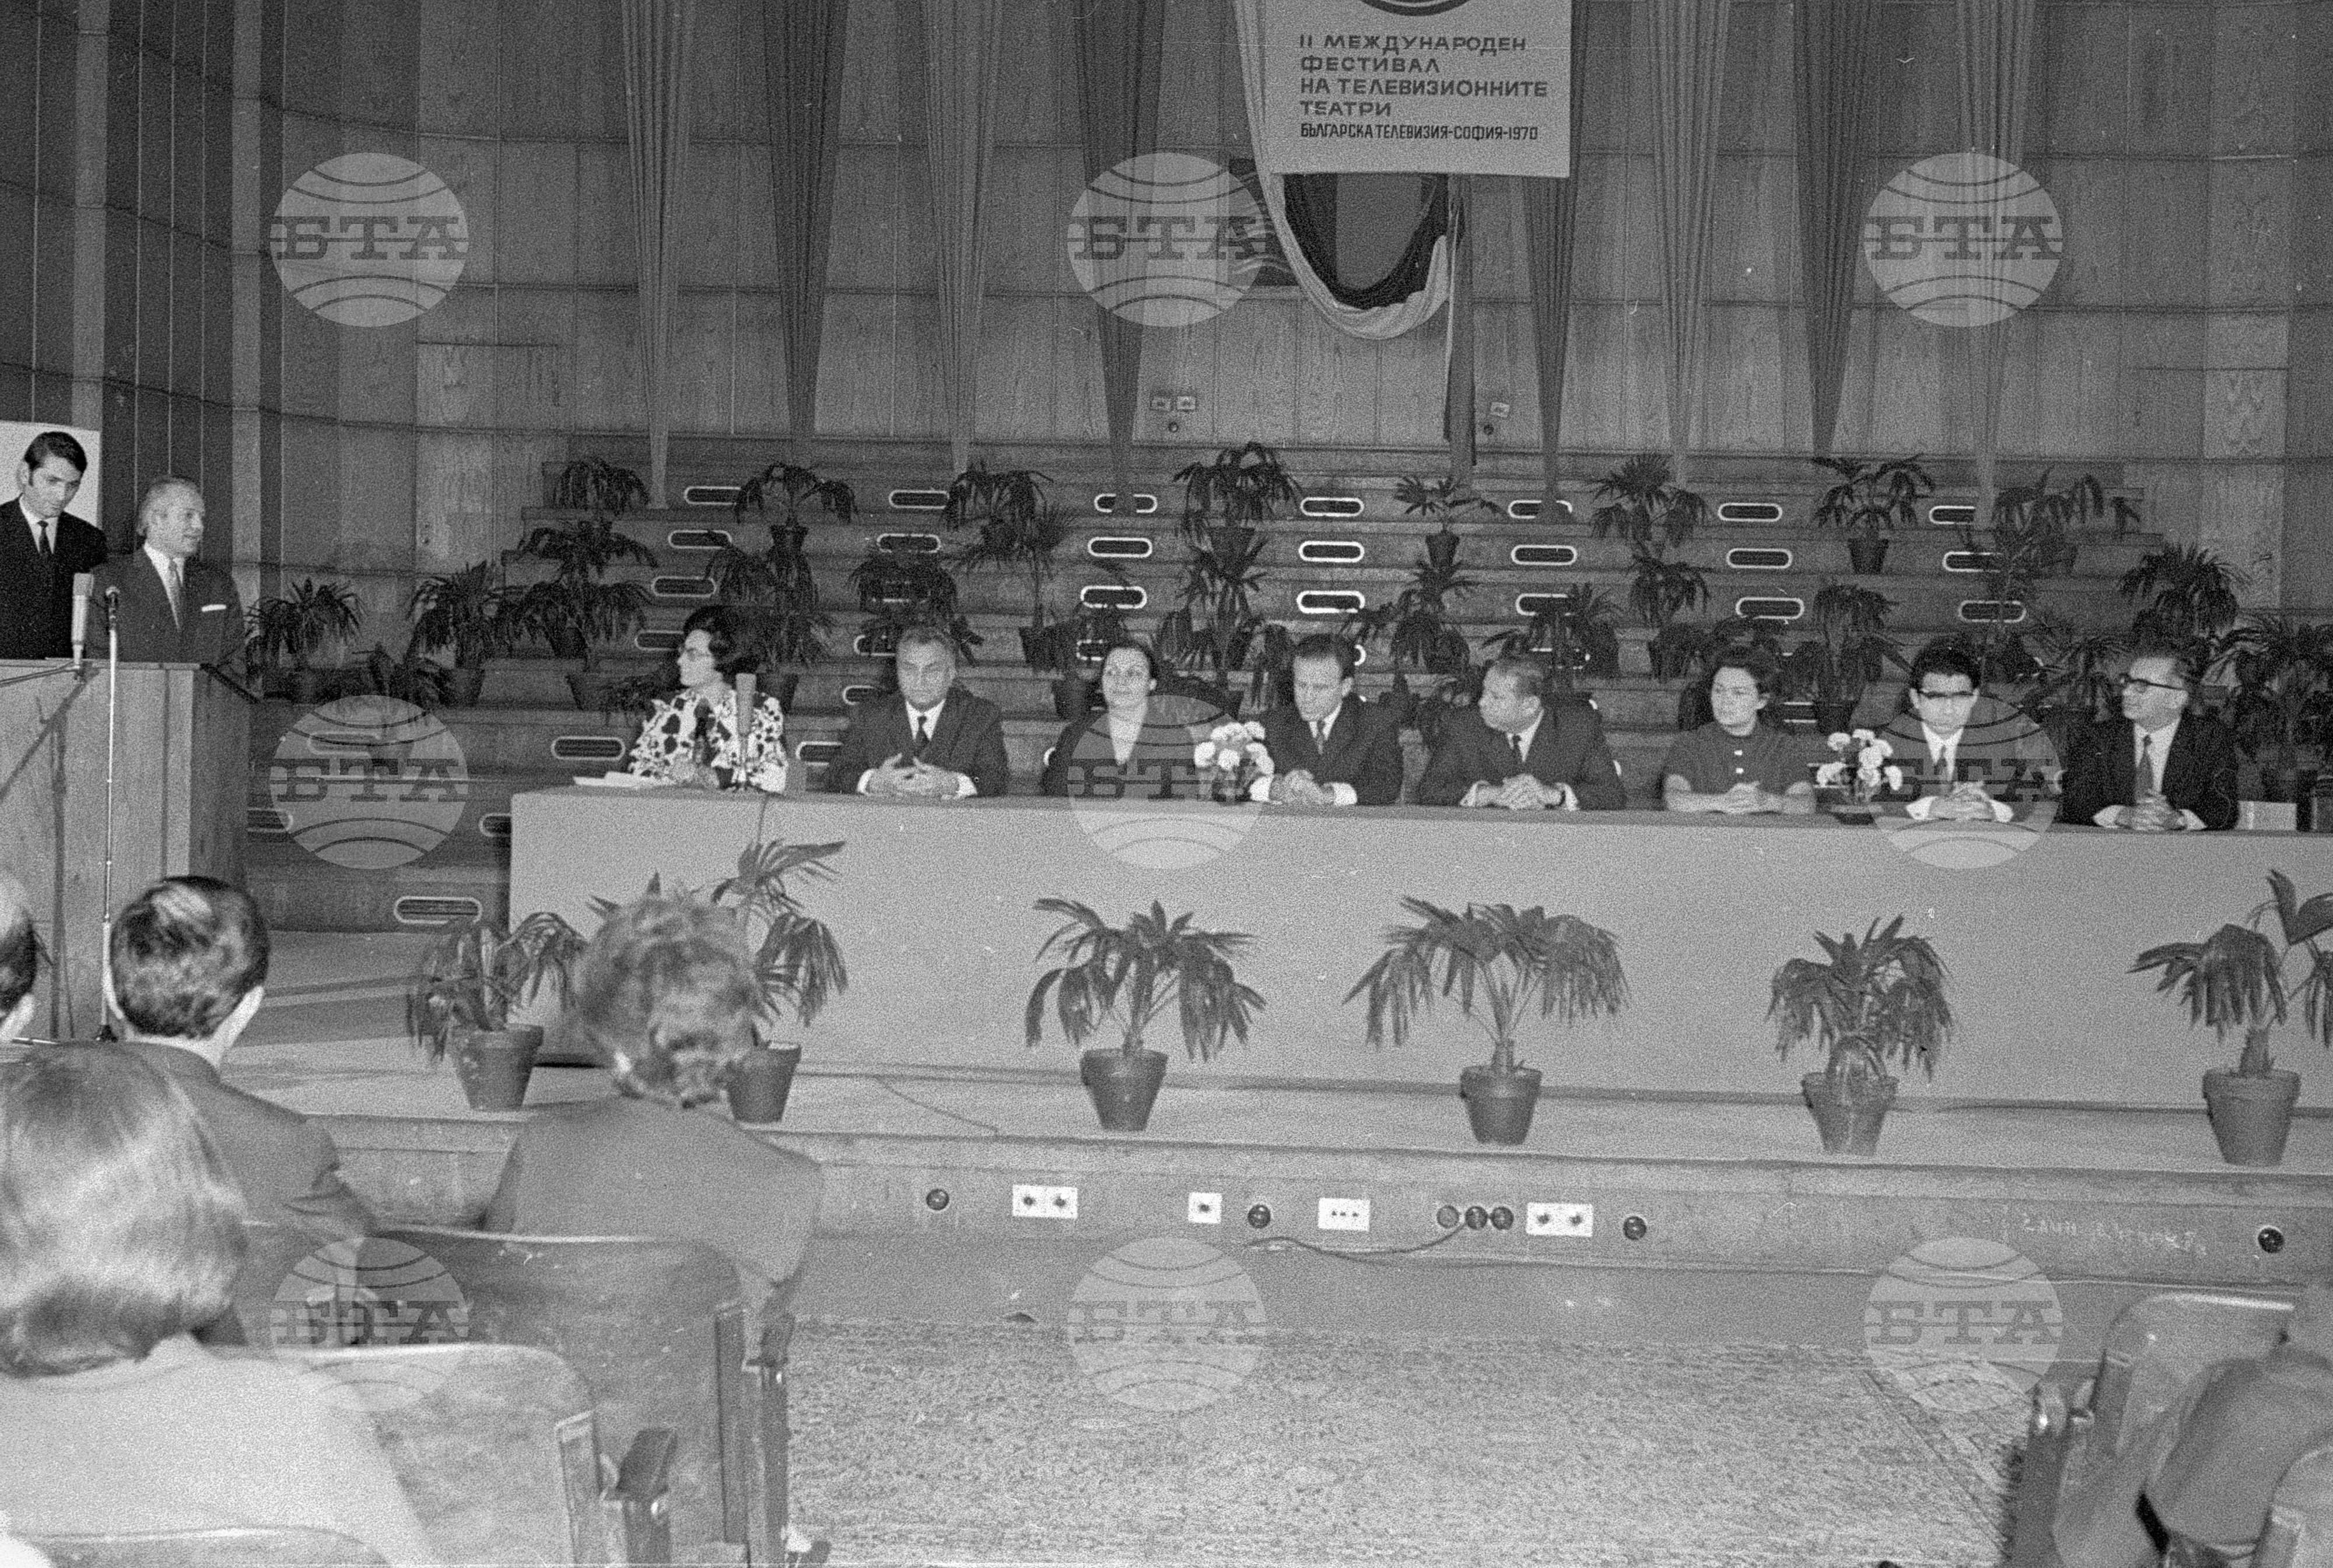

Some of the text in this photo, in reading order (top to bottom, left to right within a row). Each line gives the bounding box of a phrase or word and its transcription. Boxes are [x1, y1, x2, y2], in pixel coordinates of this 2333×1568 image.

[1324, 35, 1526, 56] МЕЖДУНАРОДЕН
[1301, 55, 1439, 73] ФЕСТИВАЛ
[1301, 78, 1547, 97] НА ТЕЛЕВИЗИОННИТЕ
[1300, 101, 1391, 117] ТЕАТРИ
[1301, 123, 1373, 138] БЪЛГАРСКА
